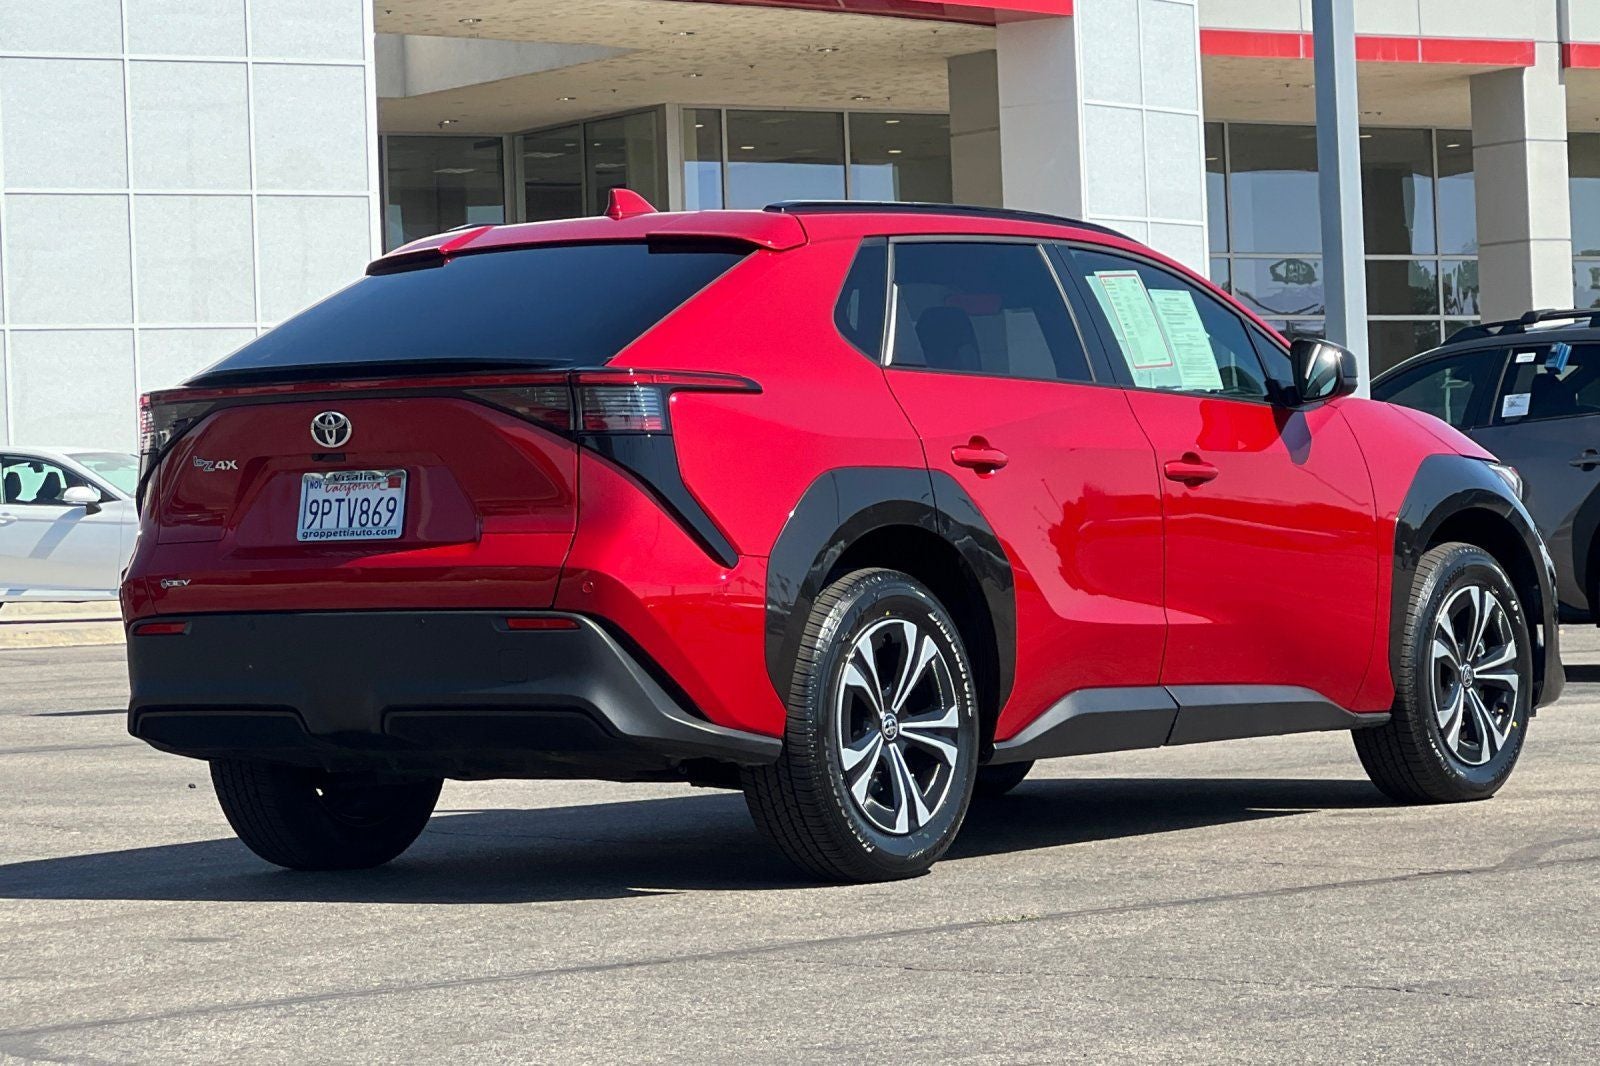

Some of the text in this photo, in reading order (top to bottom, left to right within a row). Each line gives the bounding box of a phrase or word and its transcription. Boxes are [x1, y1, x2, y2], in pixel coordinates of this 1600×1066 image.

[309, 480, 323, 489] NOV
[306, 496, 397, 529] 9PTV869
[302, 528, 397, 539] groppettiauto.com
